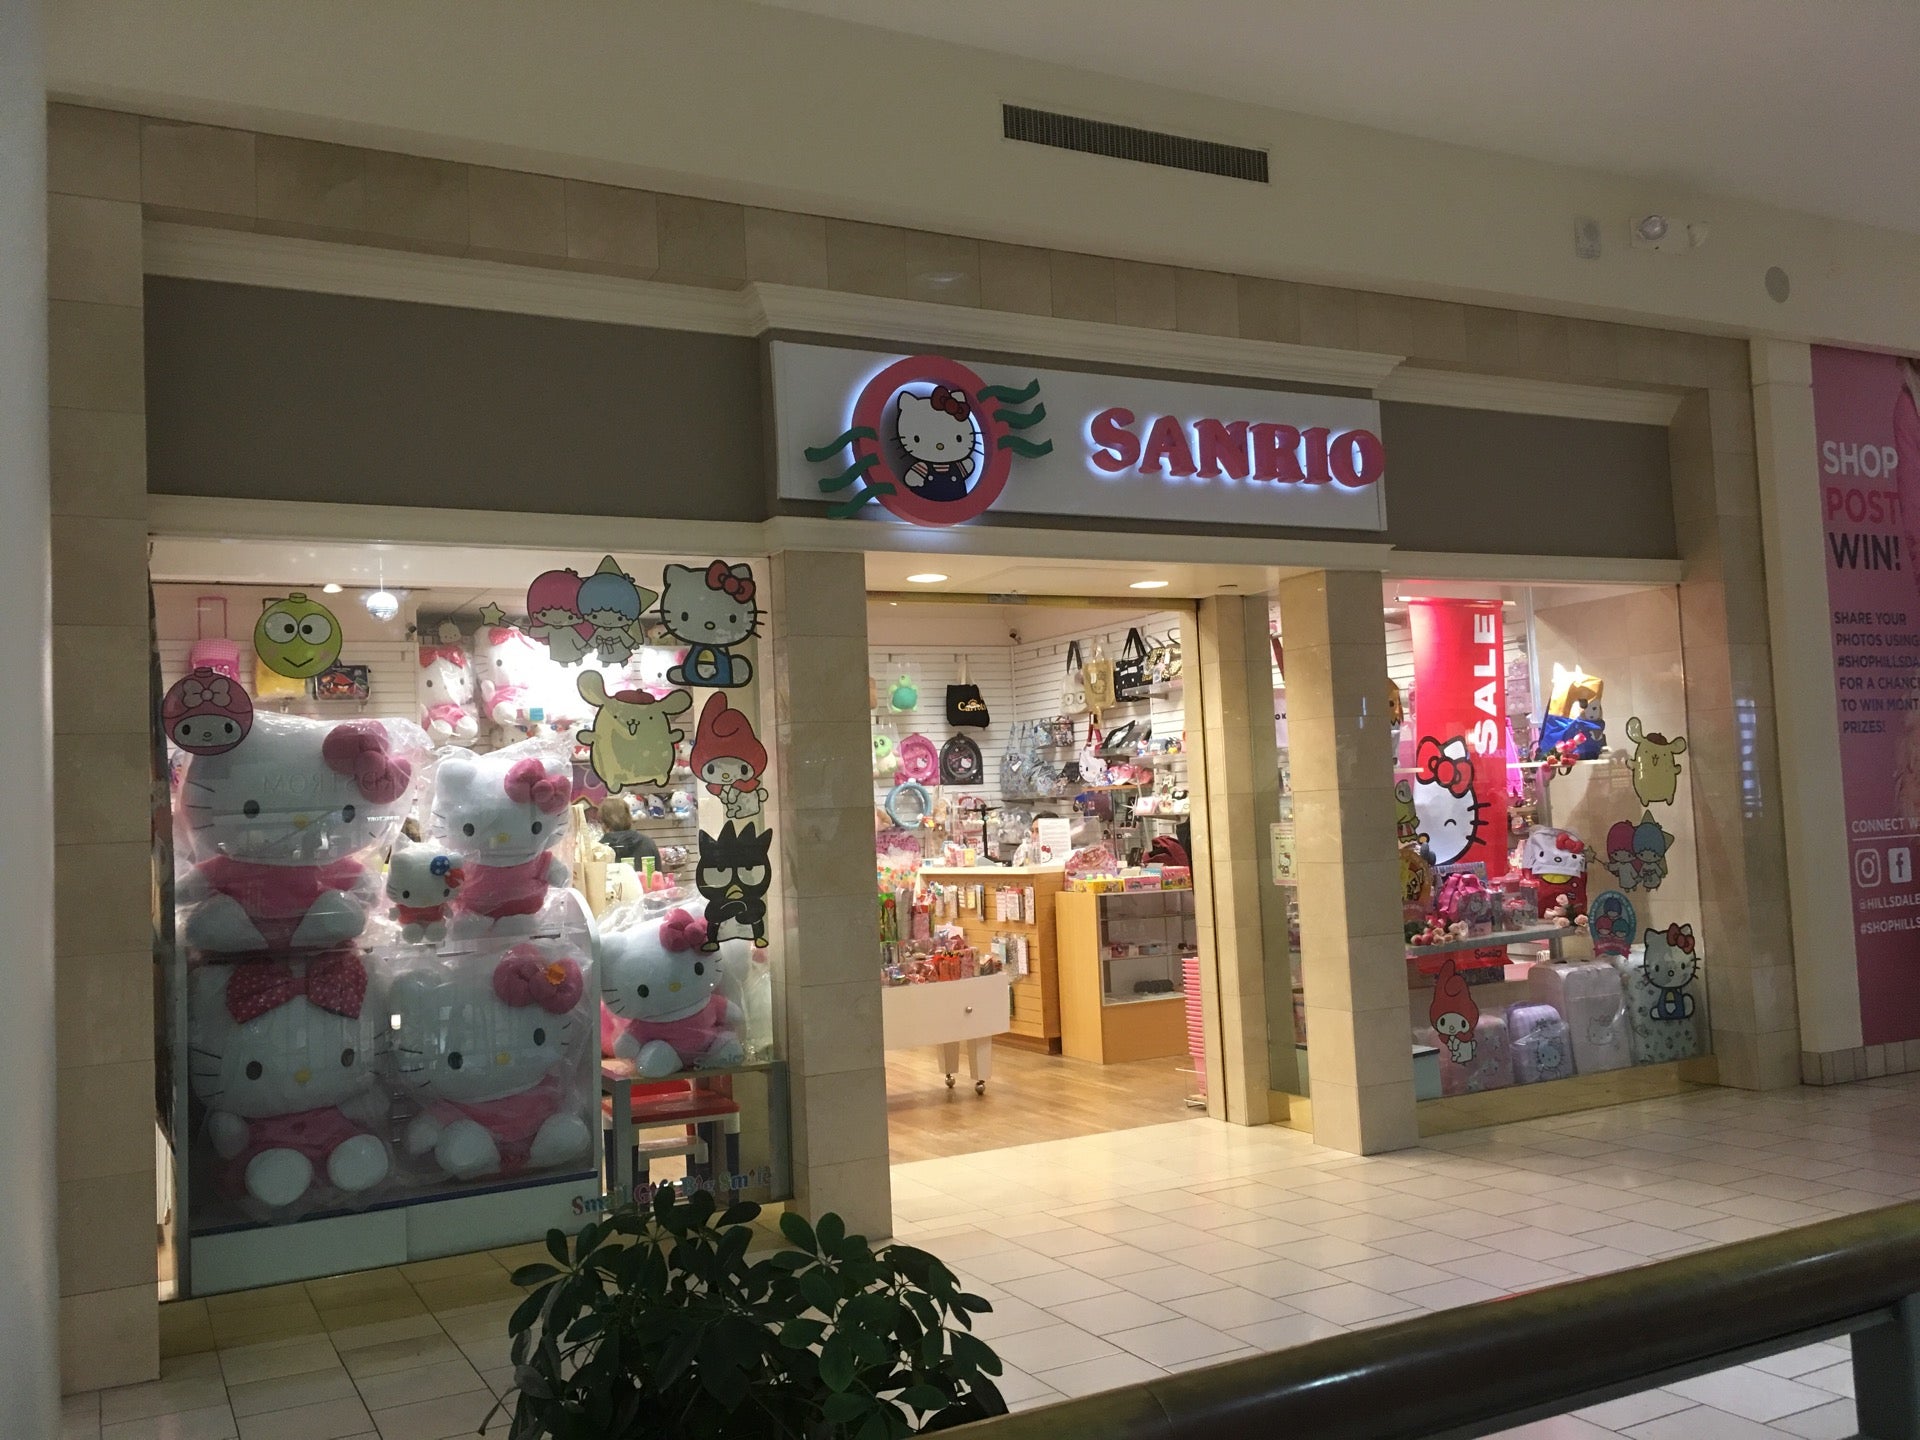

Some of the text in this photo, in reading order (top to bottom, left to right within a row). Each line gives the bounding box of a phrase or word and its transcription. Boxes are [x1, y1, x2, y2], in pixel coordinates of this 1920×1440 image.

[1090, 406, 1387, 489] SANRIO
[1822, 440, 1899, 478] SHOP
[1826, 487, 1900, 525] POST
[1828, 532, 1901, 571] WIN!
[1834, 611, 1907, 626] SHARE YOUR
[1836, 633, 1920, 647] PHOTOS USING
[1838, 655, 1920, 668] #SHOPHILLSDA
[1473, 613, 1498, 755] SALE
[1839, 677, 1863, 690] FOR
[1867, 677, 1875, 689] A
[1841, 698, 1920, 712] TO WIN MONT
[1843, 720, 1886, 734] PRIZES!
[1852, 817, 1905, 833] CONNECT
[1861, 916, 1920, 935] #SHOPHILLS
